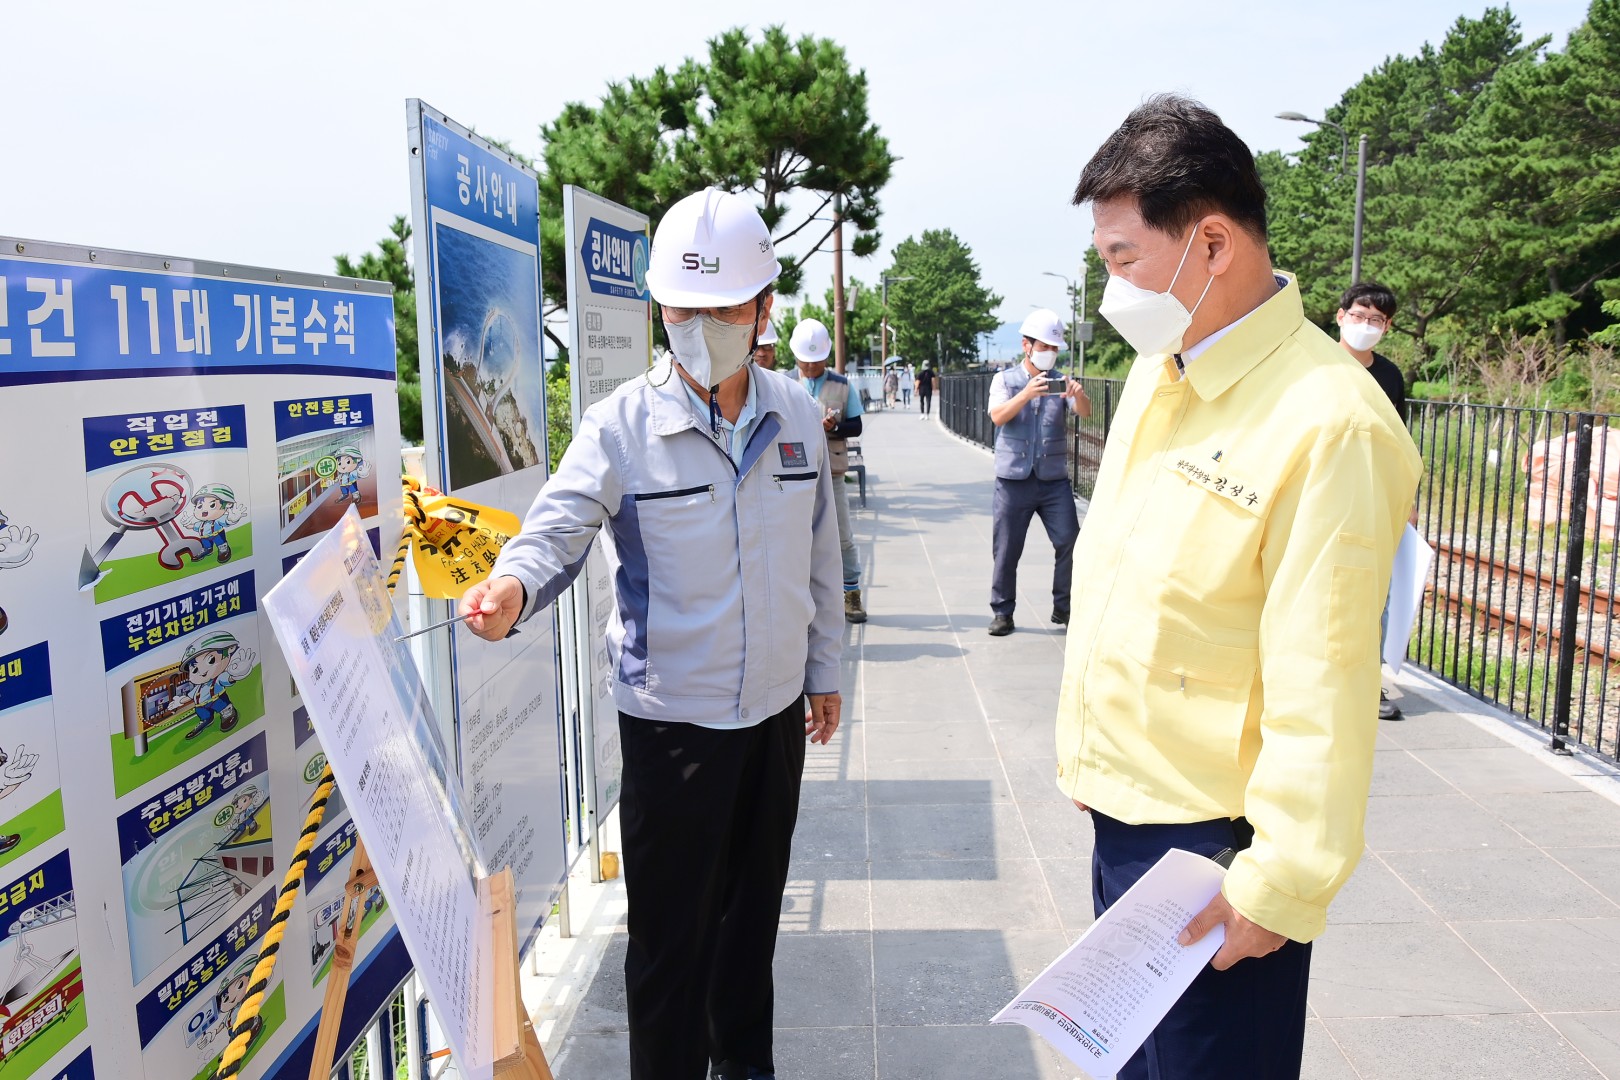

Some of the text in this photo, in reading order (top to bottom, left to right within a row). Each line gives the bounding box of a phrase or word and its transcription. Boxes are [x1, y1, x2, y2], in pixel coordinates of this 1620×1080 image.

[457, 154, 517, 226] 공사안내
[591, 230, 630, 277] 공사안내
[110, 284, 211, 355] 11대
[233, 294, 355, 355] 기본수칙
[288, 398, 351, 418] 안전통로
[333, 410, 363, 425] 확보
[109, 426, 232, 456] 안전점검
[1214, 476, 1258, 506] 김성수
[128, 595, 241, 651] 누전차단기 설치
[141, 752, 242, 820] 추락방지용
[149, 758, 253, 834] 안전망 설치
[318, 830, 358, 873] 정리
[157, 903, 264, 1003] 밀폐공간 작업전
[167, 921, 259, 1011] 산소농도 측정
[9, 1000, 58, 1045] 위험구역
[1057, 1017, 1102, 1058] 국가안전대진단
